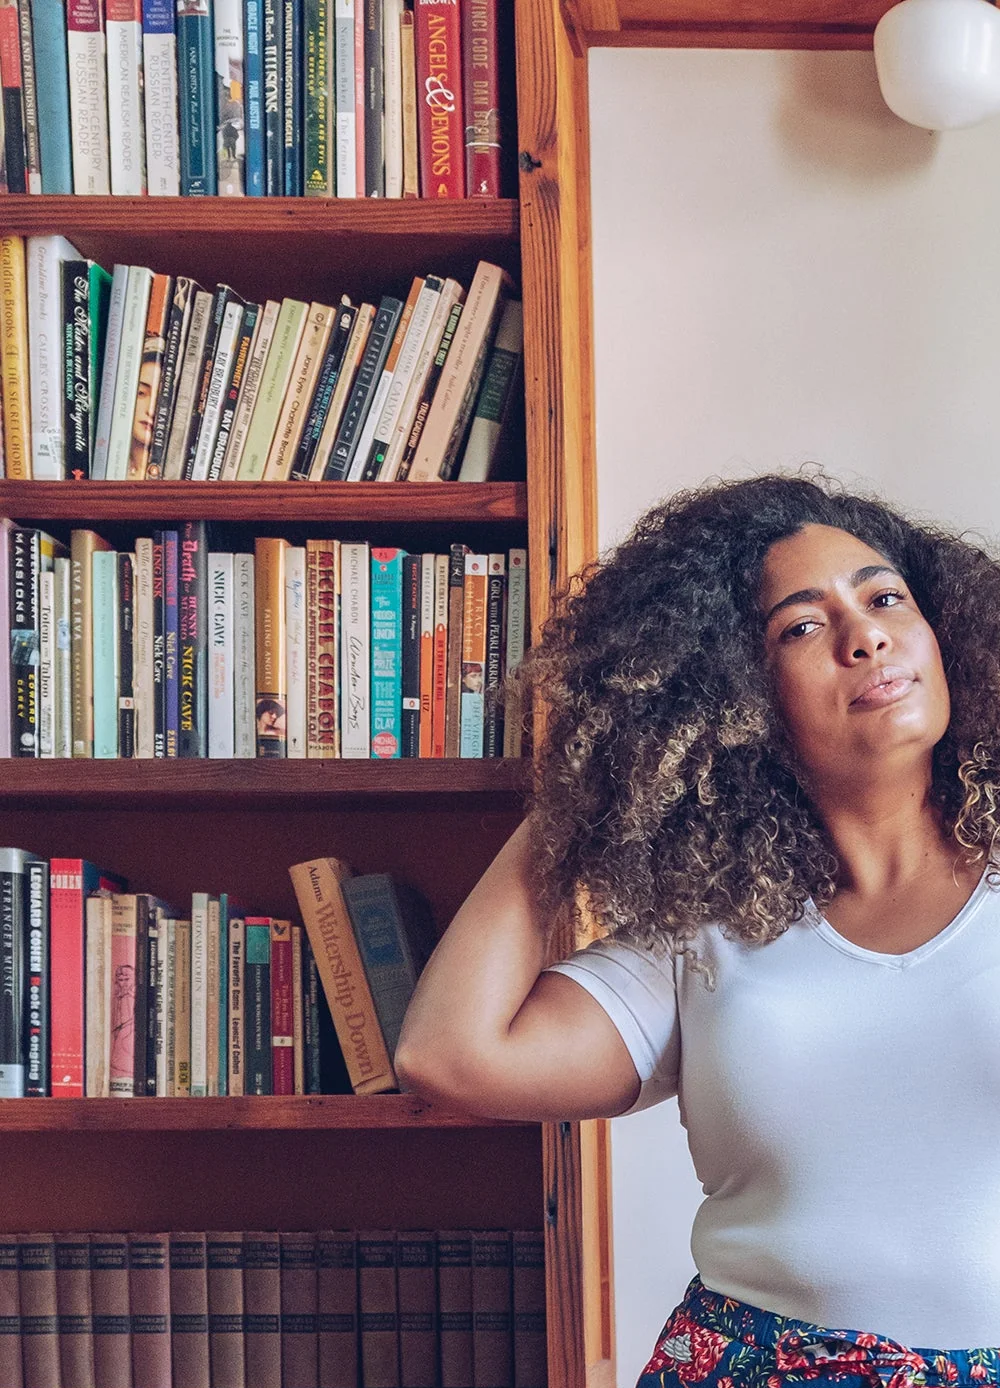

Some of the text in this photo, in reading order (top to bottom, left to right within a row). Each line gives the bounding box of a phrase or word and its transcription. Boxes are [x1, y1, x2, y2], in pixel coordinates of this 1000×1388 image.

[20, 11, 34, 126] LOVE AND FREINDSHIP
[87, 37, 101, 171] NINETEENTH-CENTURY
[249, 80, 259, 129] PAUL AUSTER
[425, 13, 455, 175] ANGELS & DEMONS
[1, 239, 22, 476] Geraldine Brooks THE SECRET CHORD
[70, 276, 88, 452] The Master and Margarita
[207, 350, 228, 409] RAY BRADBURY
[231, 336, 251, 388] FAHRENHEIT
[14, 532, 25, 623] MANSIONS
[153, 544, 163, 598] KING INK
[41, 605, 51, 698] Totem Taboo
[154, 635, 163, 683] Nick Cave
[181, 646, 193, 731] NICK CAVE
[318, 550, 335, 744] MICHAEL CHABON
[2, 880, 13, 997] STRANGER MUSIC
[29, 867, 42, 1081] LEONARD COHEN Book of Longing
[307, 865, 375, 1077] Adams Watership Down
